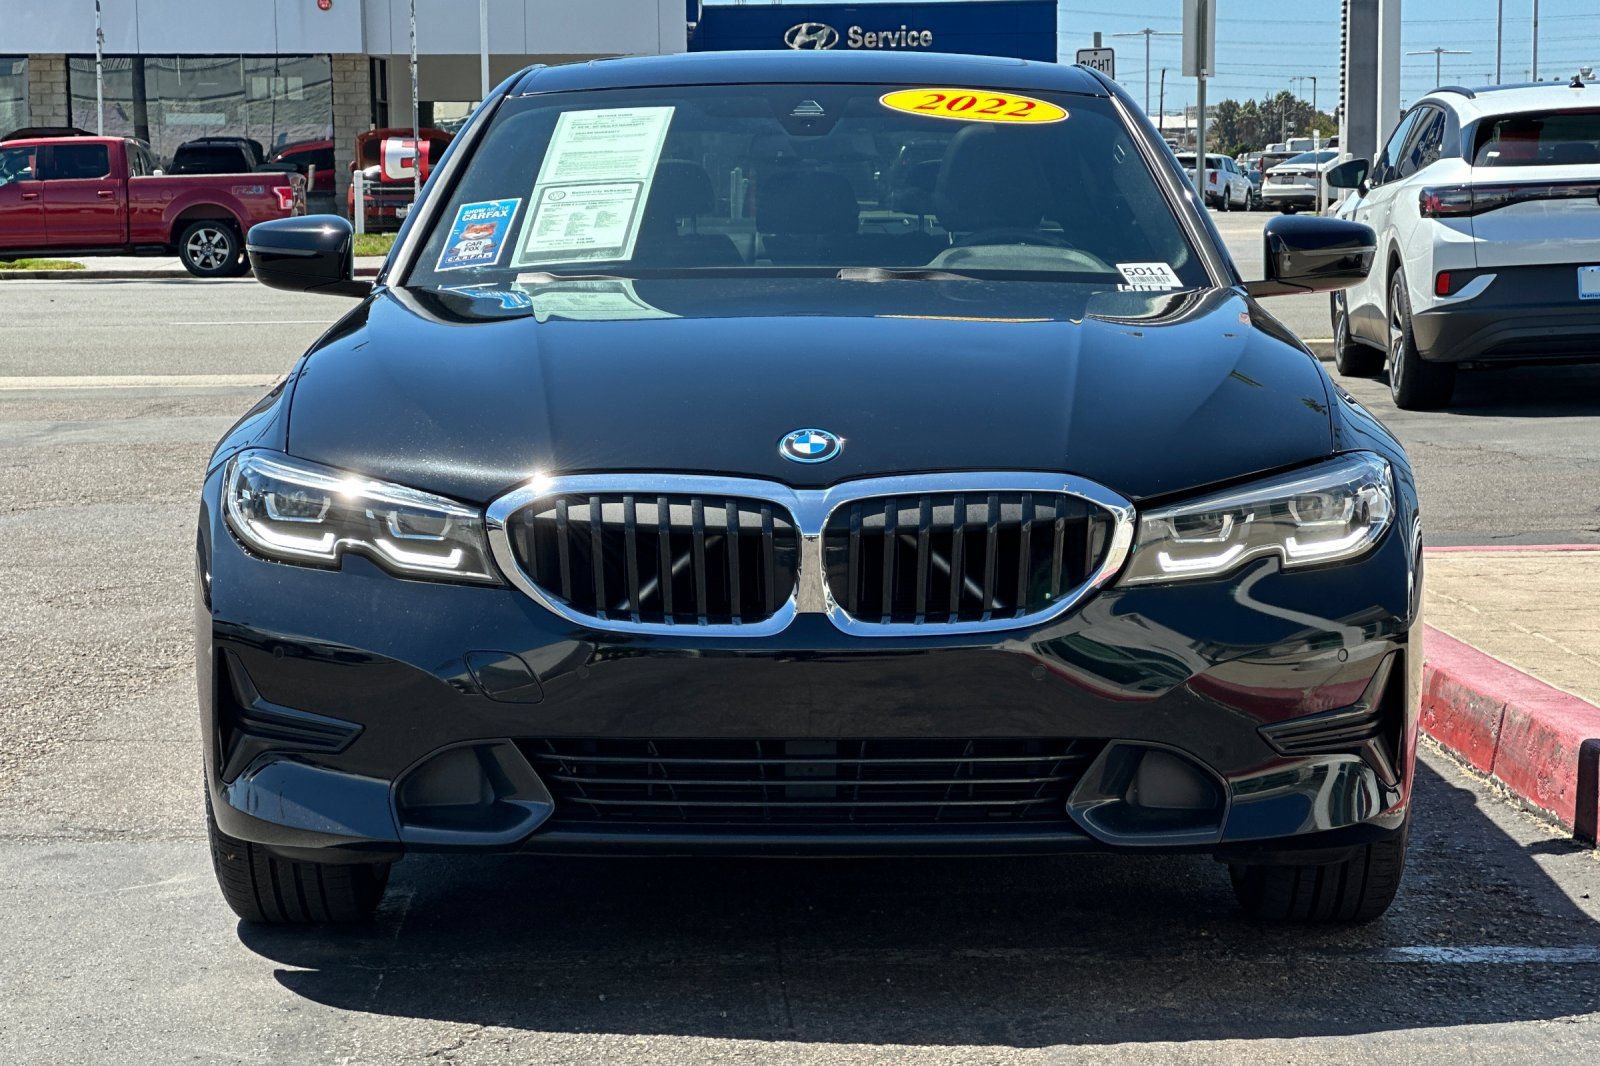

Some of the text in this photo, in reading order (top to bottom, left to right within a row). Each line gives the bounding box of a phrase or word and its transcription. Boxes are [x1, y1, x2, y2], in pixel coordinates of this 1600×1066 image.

[847, 25, 933, 48] Service
[914, 94, 1036, 117] 2022
[462, 209, 509, 221] CARFAX
[464, 207, 486, 215] SHOW
[1122, 267, 1169, 276] 5011
